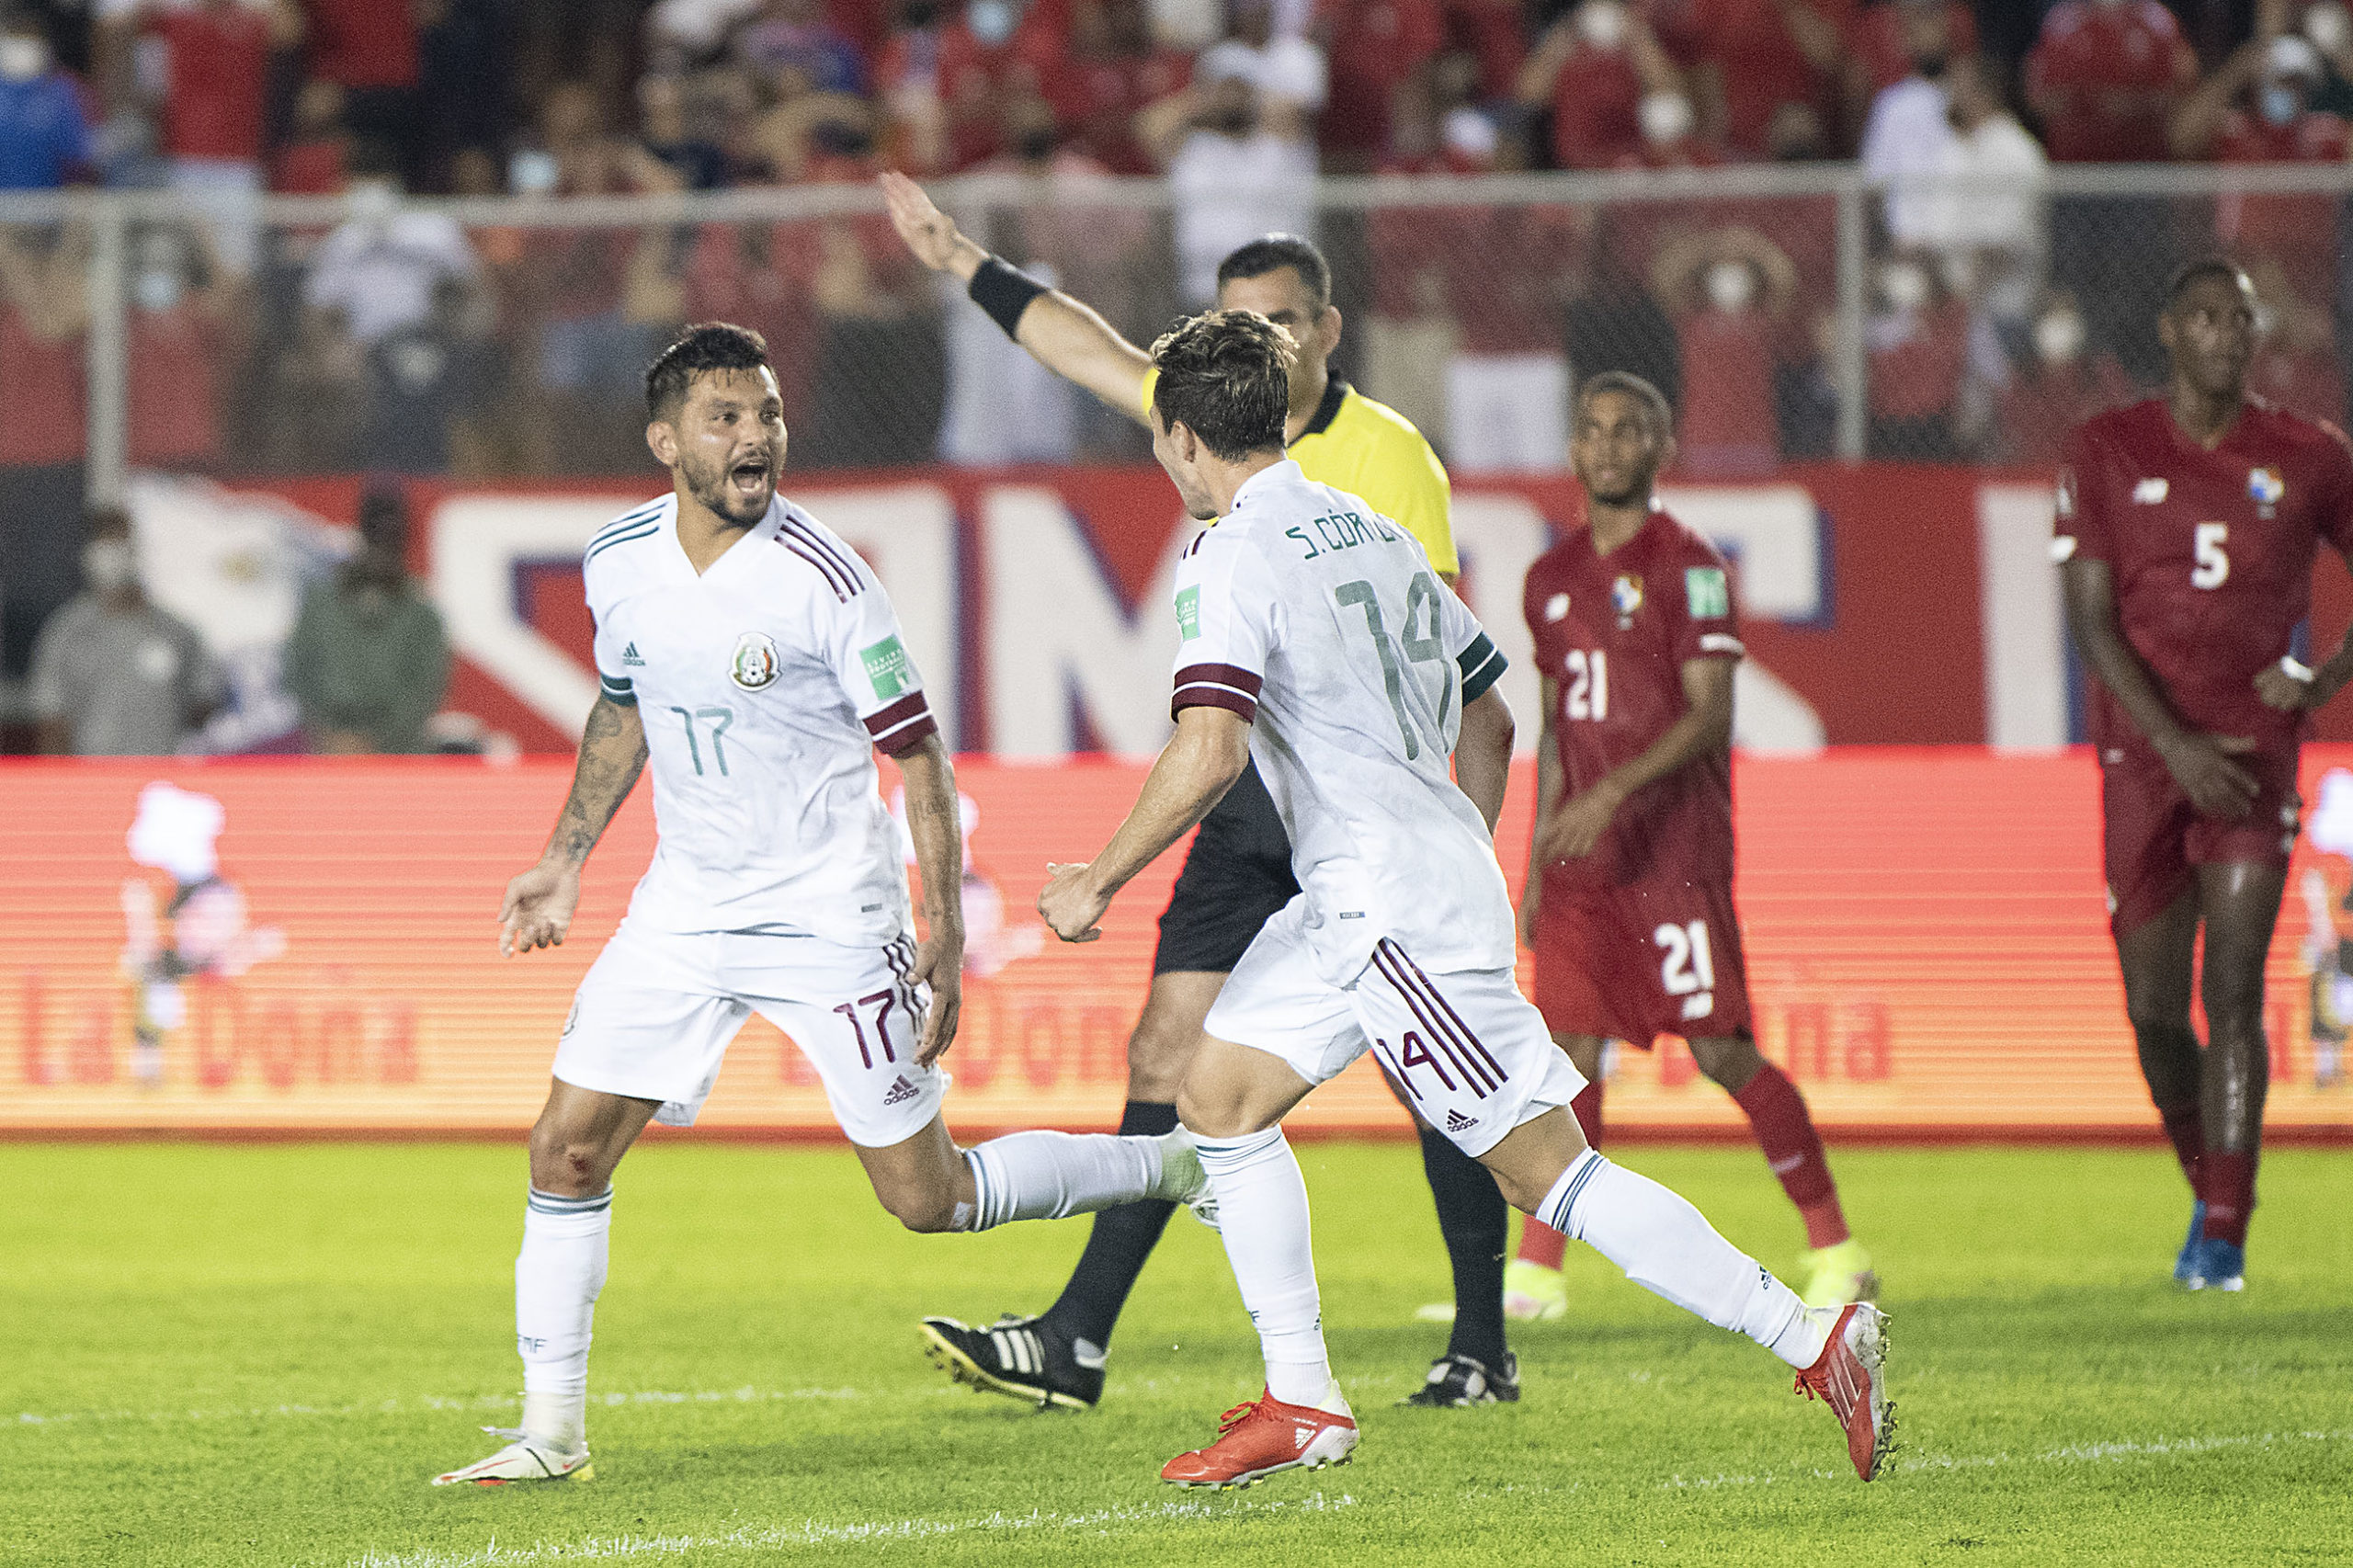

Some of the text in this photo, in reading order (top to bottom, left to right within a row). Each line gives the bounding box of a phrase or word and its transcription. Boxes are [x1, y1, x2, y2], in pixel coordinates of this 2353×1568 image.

[2190, 521, 2230, 590] 5
[1336, 571, 1453, 761] 14
[1565, 648, 1608, 722] 21
[670, 706, 733, 778] 17
[1654, 919, 1714, 995] 21
[833, 988, 896, 1070] 17
[883, 1087, 920, 1106] adidas
[1376, 1030, 1457, 1101] 14
[1448, 1118, 1480, 1132] adidas
